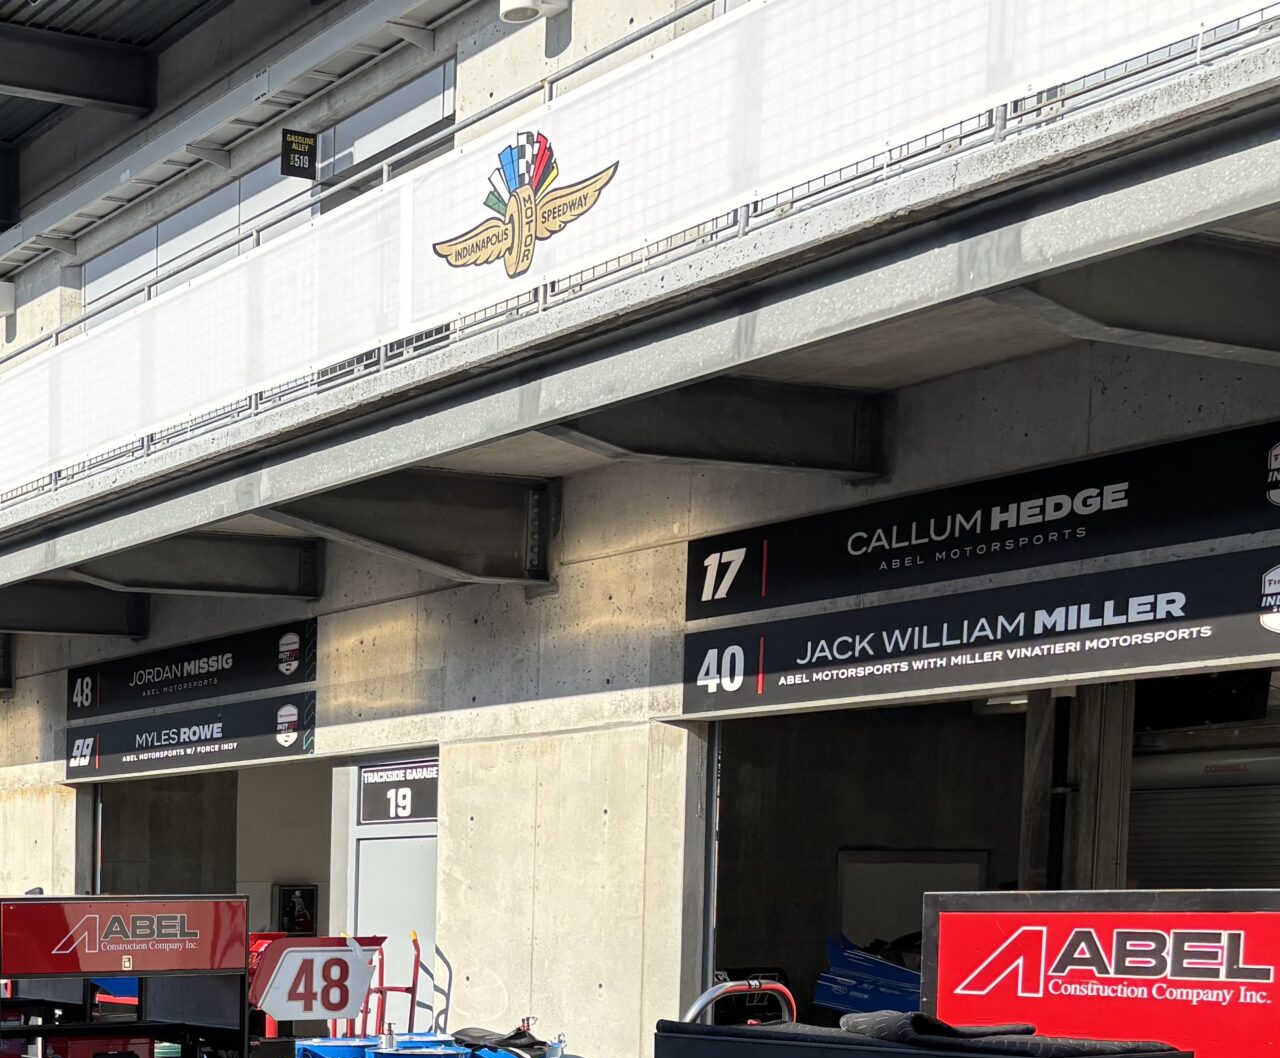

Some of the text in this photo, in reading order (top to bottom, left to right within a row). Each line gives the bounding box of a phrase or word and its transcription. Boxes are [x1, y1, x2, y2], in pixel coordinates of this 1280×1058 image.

[286, 134, 315, 145] GASOLINE
[292, 144, 309, 152] ALLEY
[294, 155, 309, 168] 519
[454, 193, 589, 263] INDIANAPOLIS MOTOR SPEEDWAY
[847, 481, 1129, 556] CALLUM HEDGE
[879, 527, 1087, 571] ABEL MOTORSPORTS
[701, 548, 747, 602] 17
[796, 591, 1186, 665] JACK WILLIAM MILLER
[129, 653, 233, 687] JORDAN MISSIG
[697, 645, 745, 693] 40
[778, 626, 1212, 686] ABEL MOTORSPORTS WITH MILLER VINATIERI MOTORSPORTS
[73, 676, 92, 707] 48
[142, 677, 218, 697] ABEL MOTORSPORTS
[135, 722, 223, 749] MYLES ROWE
[69, 738, 94, 767] 99
[139, 749, 185, 761] MOTORSPORTS
[196, 744, 220, 754] FORCE
[221, 742, 238, 751] INDY
[363, 766, 439, 784] TRACKSIDE GARAGE
[386, 787, 412, 818] 19
[101, 914, 200, 940] ABEL
[101, 940, 199, 951] Construction Company Inc.
[1047, 928, 1275, 983] ABEL
[287, 957, 350, 1012] 48
[1048, 979, 1273, 1005] Construction Company Inc.
